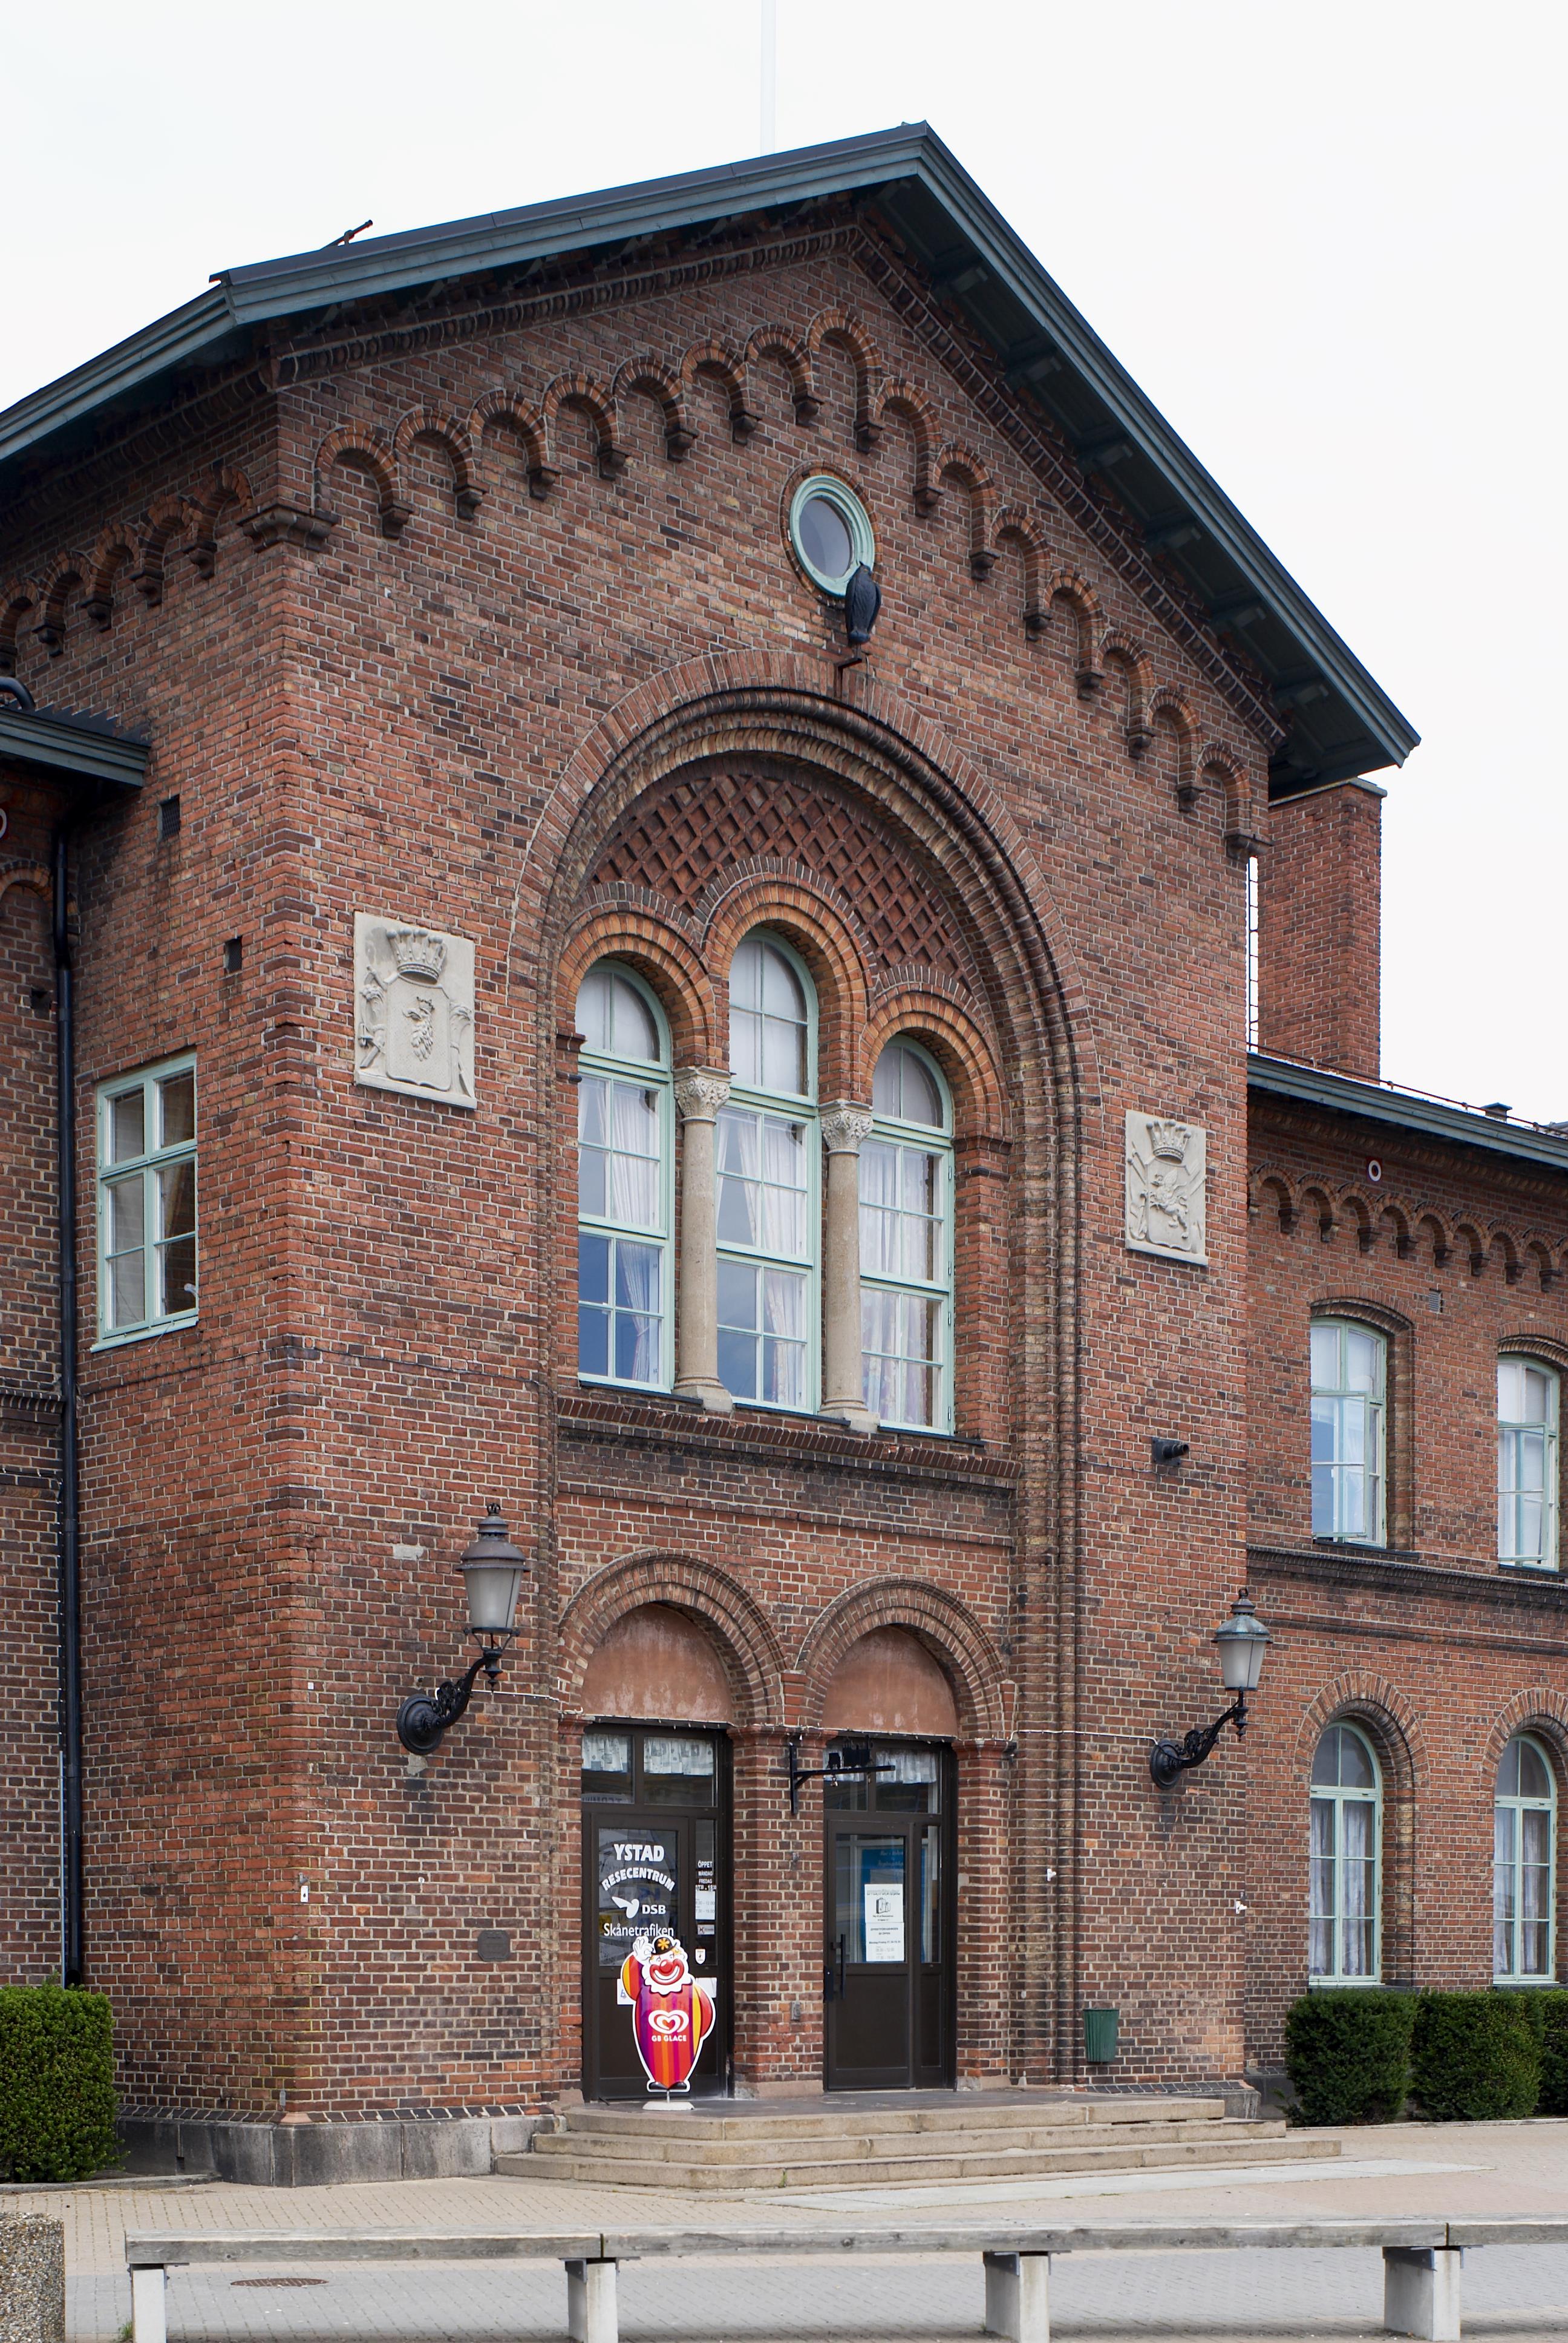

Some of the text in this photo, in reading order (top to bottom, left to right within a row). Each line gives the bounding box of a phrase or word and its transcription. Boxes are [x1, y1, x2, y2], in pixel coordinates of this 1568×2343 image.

[613, 1844, 665, 1862] YSTAD
[601, 1867, 675, 1892] RESECENTRUM
[642, 1904, 666, 1915] DSB
[604, 1922, 674, 1936] Skånetrafiken
